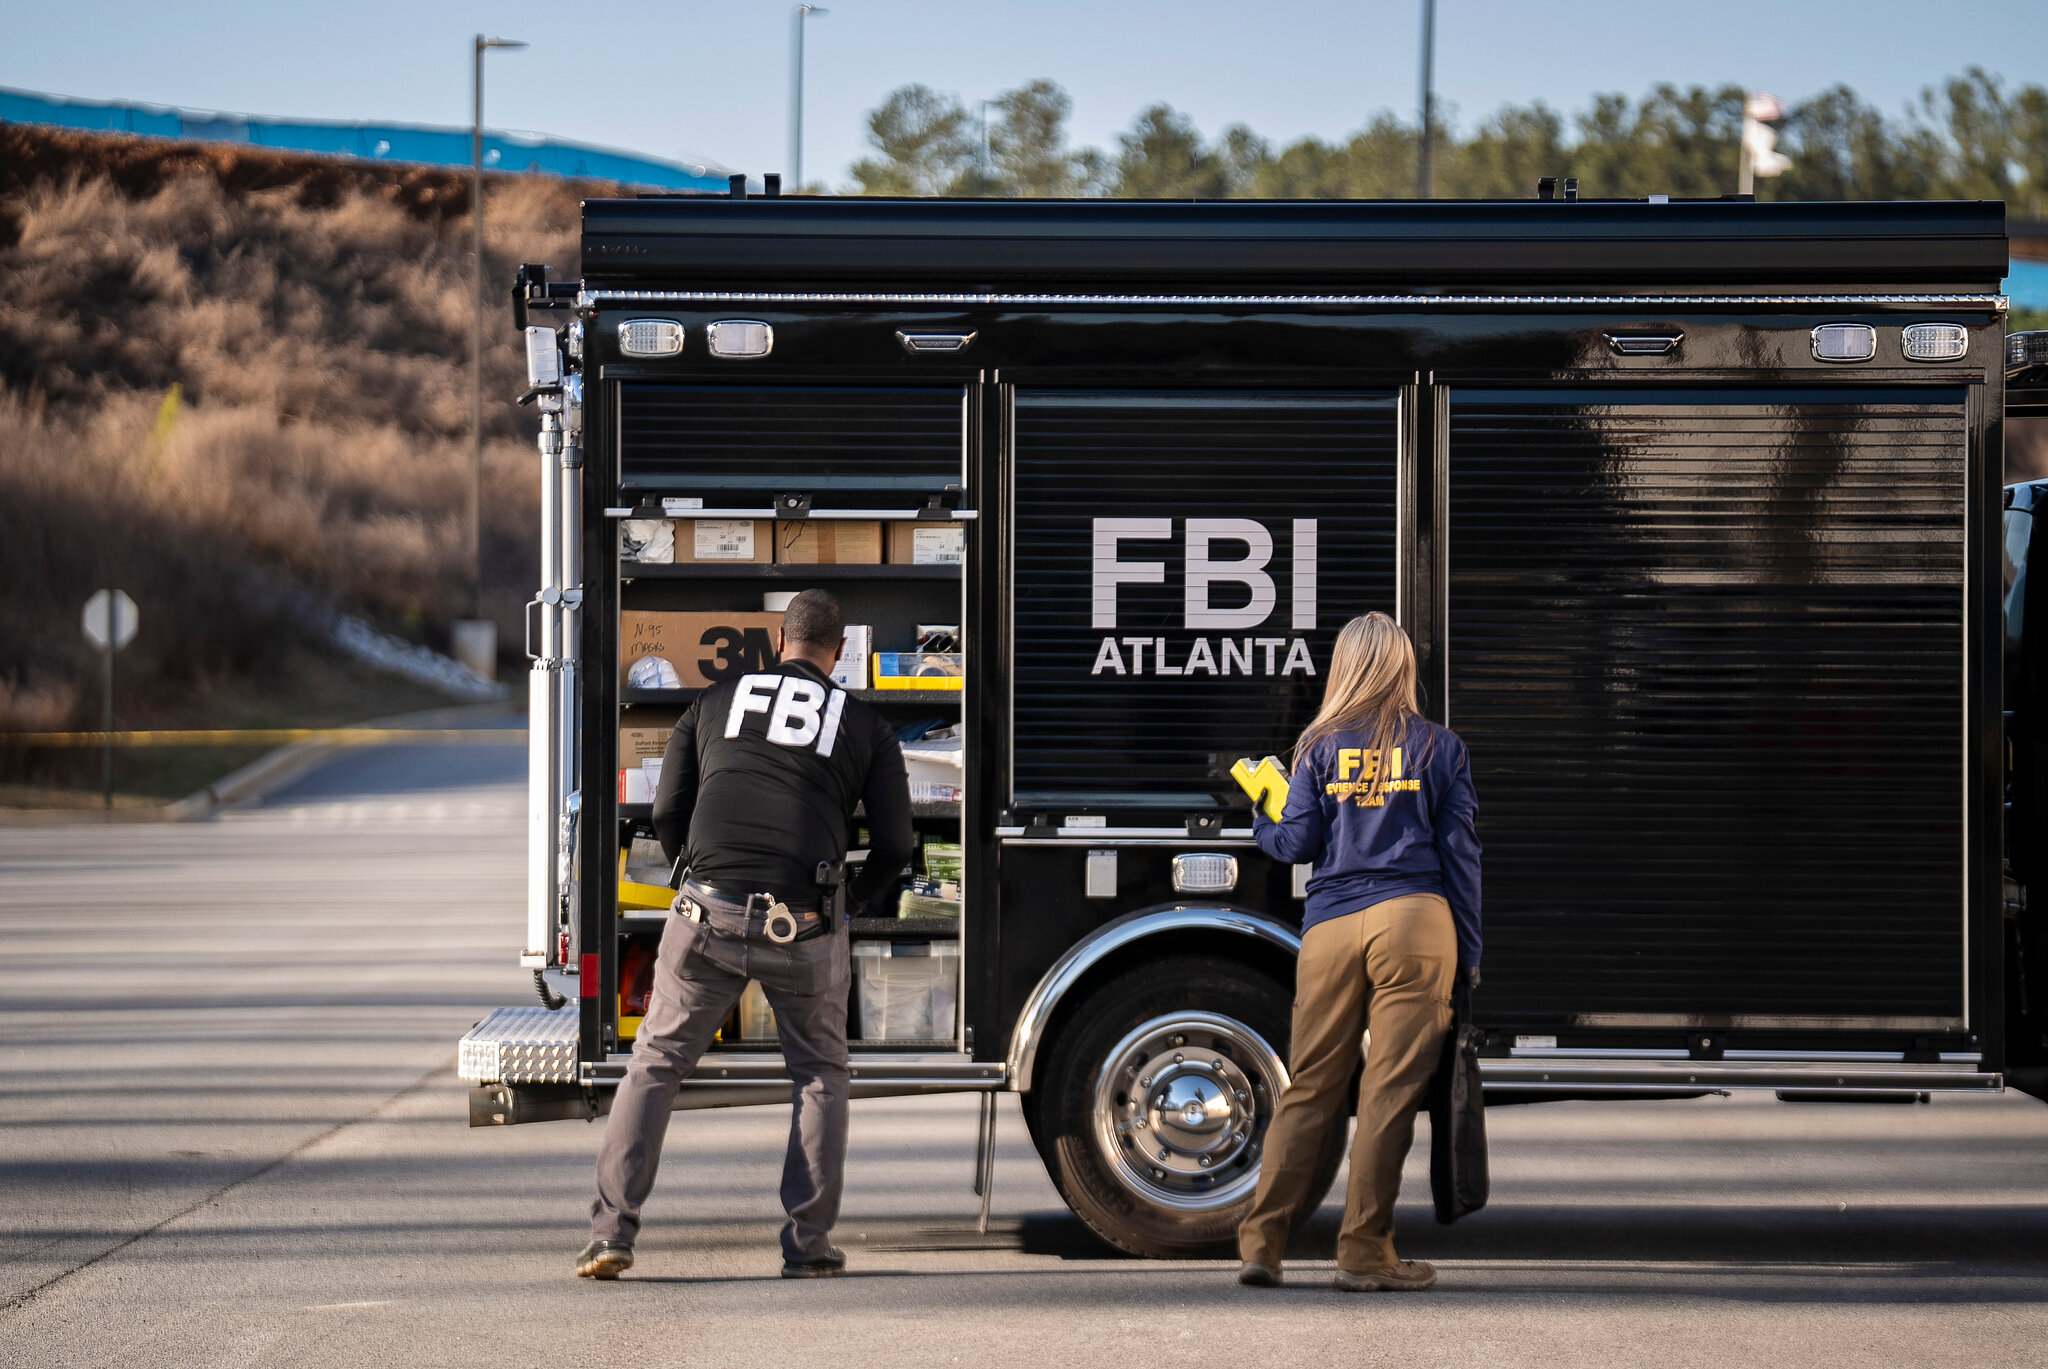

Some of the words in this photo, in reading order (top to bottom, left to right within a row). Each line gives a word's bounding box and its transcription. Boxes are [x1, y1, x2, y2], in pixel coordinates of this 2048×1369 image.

[1091, 518, 1318, 630] FBI
[634, 623, 663, 638] N-95
[697, 626, 780, 681] 3M
[1091, 637, 1316, 676] ATLANTA
[724, 673, 847, 758] FBI
[1338, 747, 1402, 780] FBI
